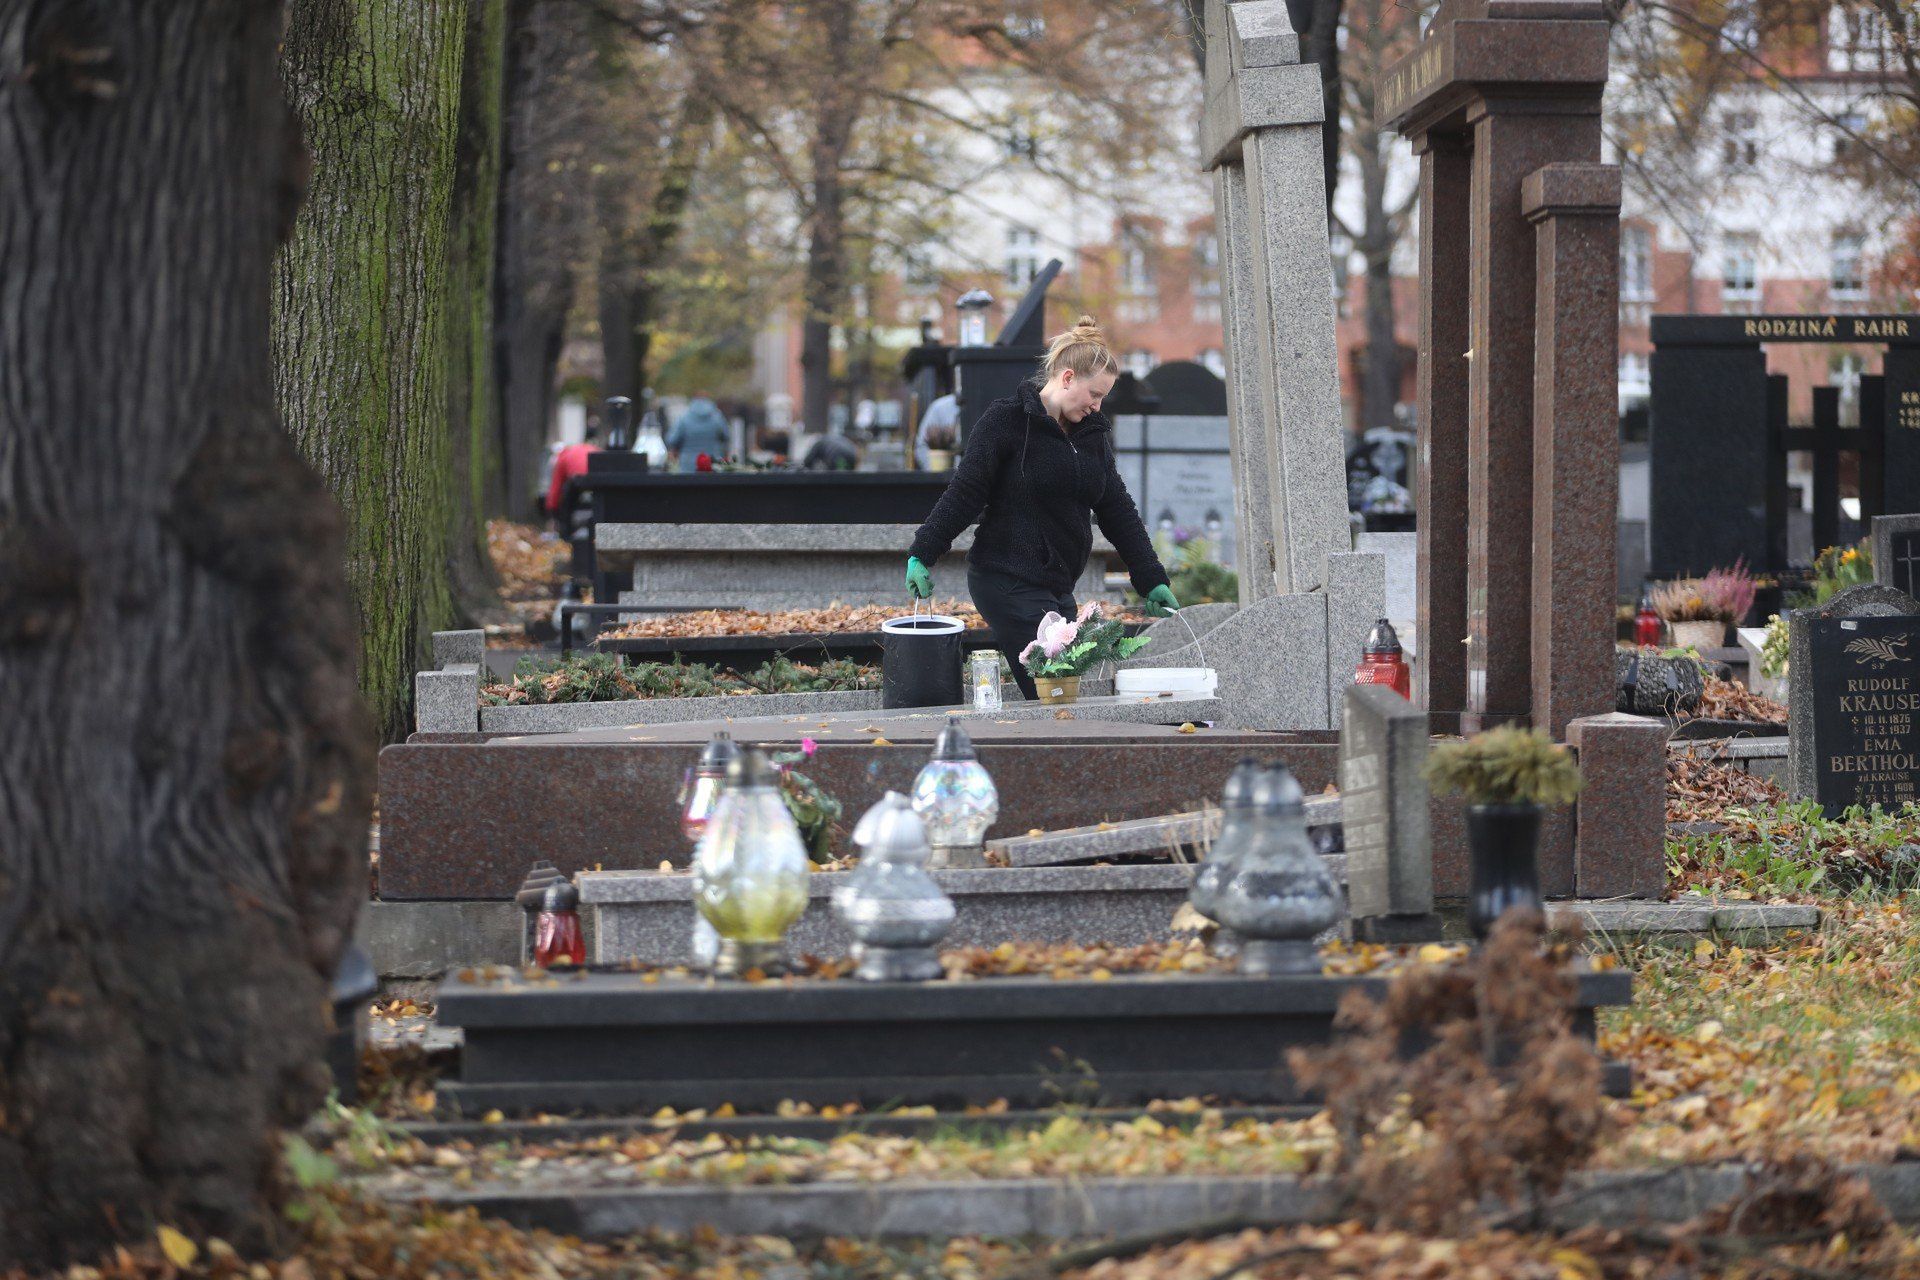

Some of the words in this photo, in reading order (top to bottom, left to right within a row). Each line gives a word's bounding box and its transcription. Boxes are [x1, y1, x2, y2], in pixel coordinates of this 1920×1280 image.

[1745, 319, 1835, 337] RODZINA
[1854, 319, 1909, 337] RAHR
[1847, 677, 1910, 692] RUDOLF
[1839, 693, 1920, 712] KRAUSE
[1863, 737, 1901, 752] EMA
